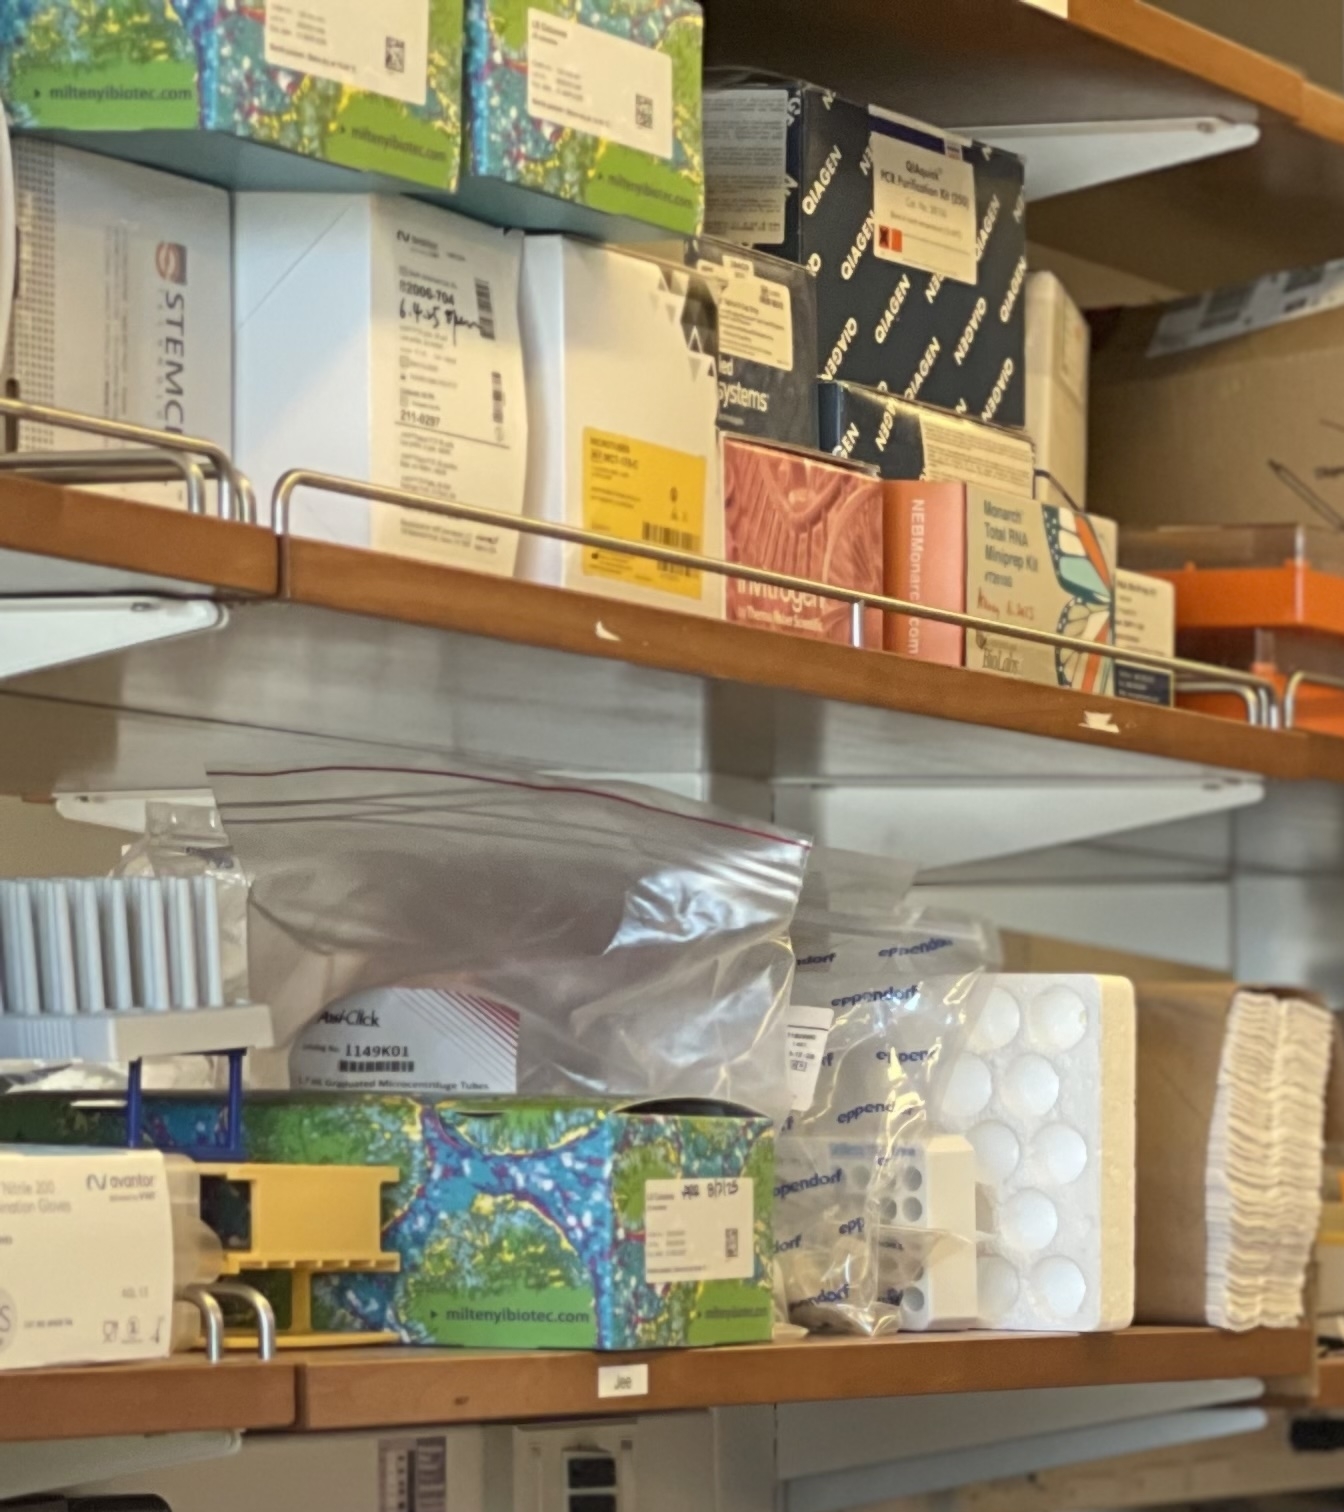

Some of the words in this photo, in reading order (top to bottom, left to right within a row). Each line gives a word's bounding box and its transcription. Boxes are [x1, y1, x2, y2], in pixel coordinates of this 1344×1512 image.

[49, 86, 193, 101] miltenyibiotec.com
[801, 145, 843, 216] QIAGEN
[875, 273, 912, 344] QIAGEN
[954, 297, 987, 365] QIAGEN
[981, 357, 1014, 423] QIAGEN
[984, 522, 1007, 541] Total
[1009, 527, 1029, 547] RNA
[907, 498, 925, 655] NEBMonarccom
[985, 545, 1024, 572] Miniprep
[109, 1173, 155, 1190] avantor
[446, 1308, 590, 1325] miltenyibiotec.com
